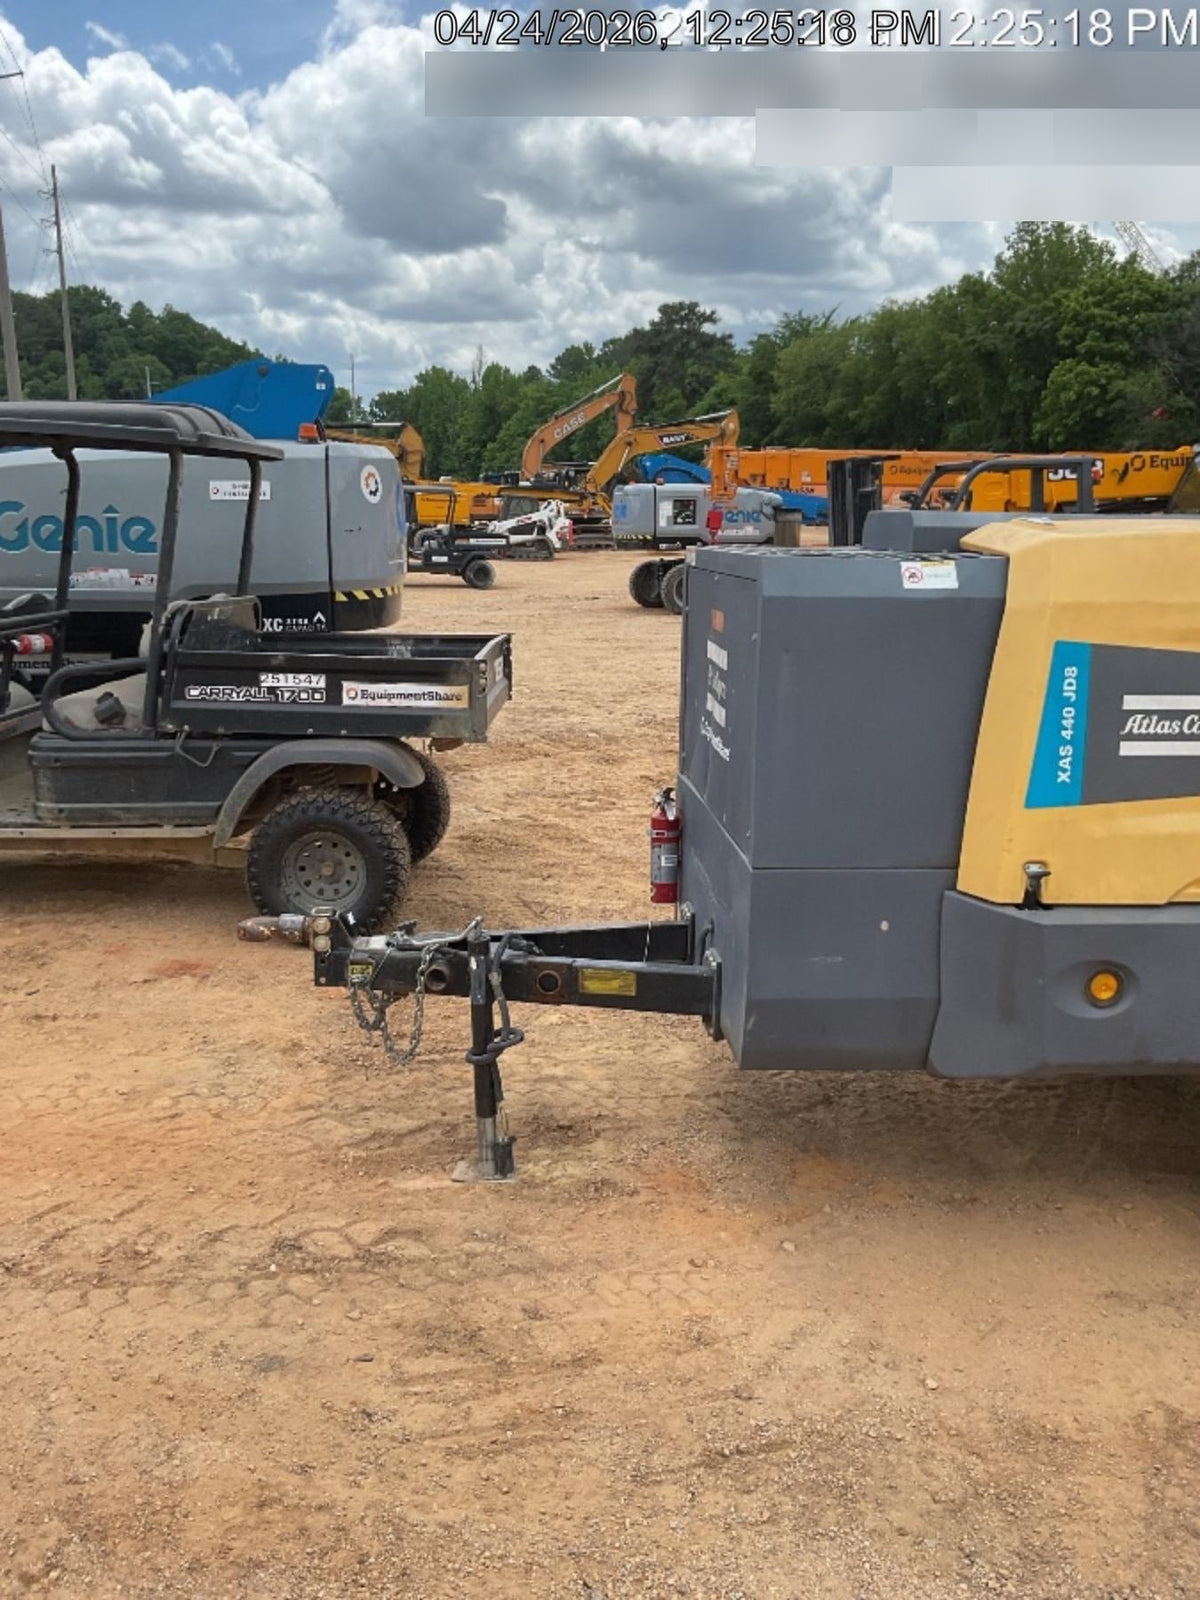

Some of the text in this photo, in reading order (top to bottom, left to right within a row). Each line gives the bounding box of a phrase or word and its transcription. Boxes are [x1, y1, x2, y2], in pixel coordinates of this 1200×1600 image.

[554, 412, 586, 439] CASE
[721, 510, 762, 523] enie
[0, 500, 157, 554] Genie
[262, 618, 283, 632] XC
[259, 673, 324, 686] 251547
[185, 686, 326, 703] CARRYALL 1700
[360, 689, 463, 702] EquipmentShare
[1057, 666, 1079, 783] XAS 440 JD8
[1119, 713, 1181, 735] Atlas
